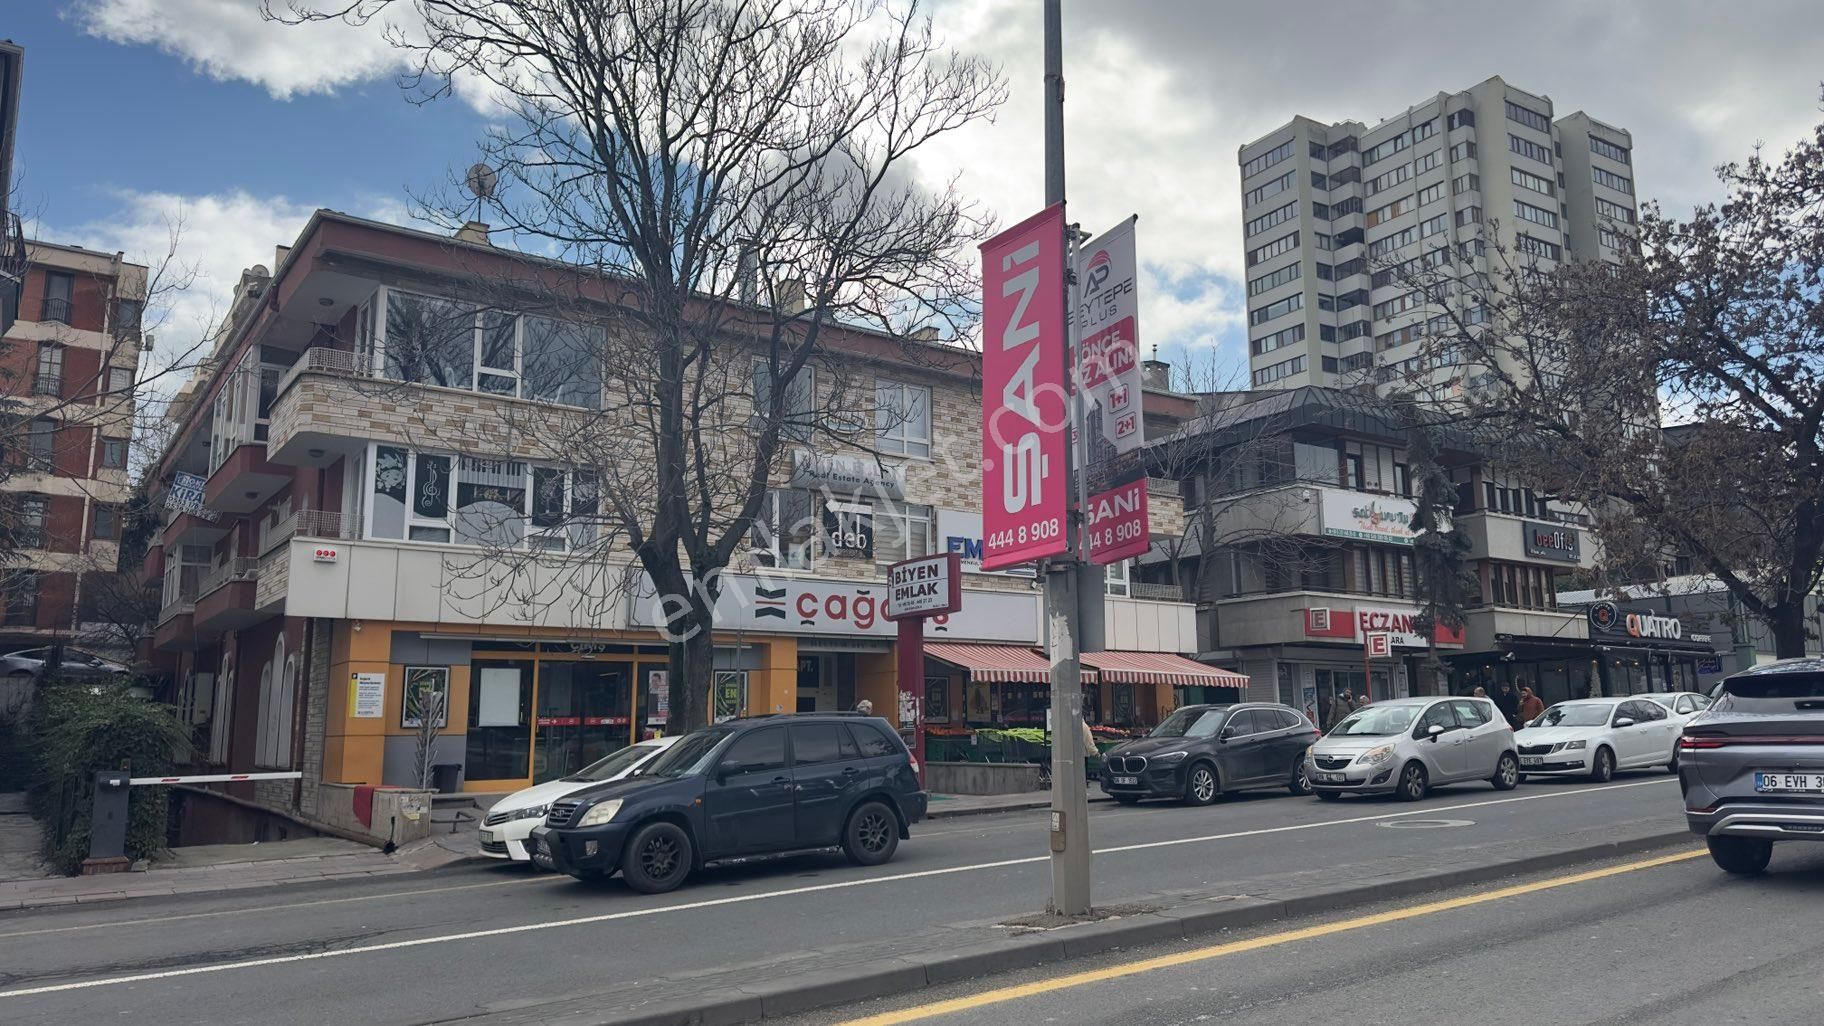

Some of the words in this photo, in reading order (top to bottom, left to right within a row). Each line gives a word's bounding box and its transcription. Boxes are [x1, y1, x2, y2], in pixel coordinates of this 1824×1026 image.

[1117, 416, 1134, 435] 2+1
[832, 472, 861, 483] Estate
[988, 529, 1014, 549] 444
[1018, 526, 1027, 544] 8
[1031, 518, 1059, 541] 908
[1105, 528, 1113, 545] 8
[1116, 519, 1142, 541] 908
[895, 564, 939, 585] BİYEN
[895, 582, 939, 601] EMLAK
[1314, 613, 1325, 627] E
[1373, 638, 1385, 653] E
[1763, 775, 1778, 787] 06
[1785, 775, 1807, 788] EVH
[1815, 776, 1824, 788] 3
